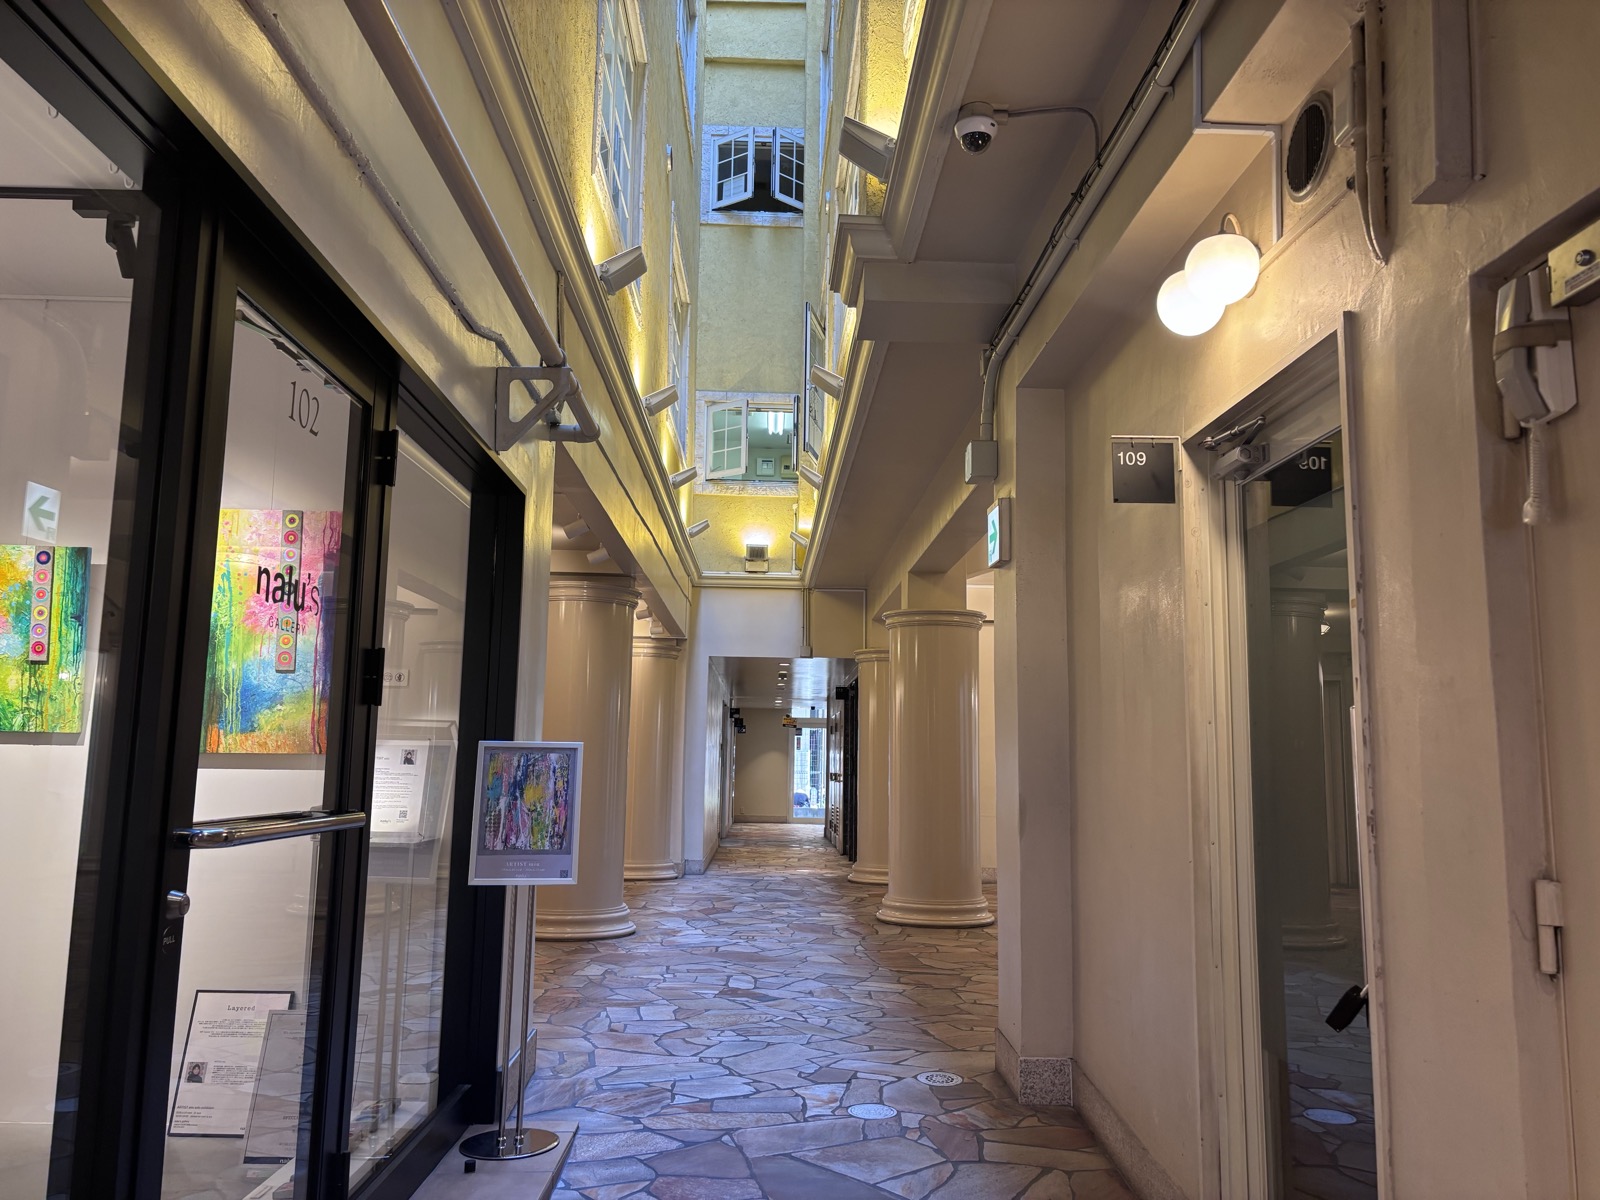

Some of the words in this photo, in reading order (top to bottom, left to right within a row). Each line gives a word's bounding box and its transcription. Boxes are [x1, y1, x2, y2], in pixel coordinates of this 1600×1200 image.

[288, 381, 320, 437] 102
[1117, 451, 1147, 466] 109
[256, 565, 320, 617] nalu's
[268, 615, 306, 634] GALLERY
[162, 935, 176, 946] PULL
